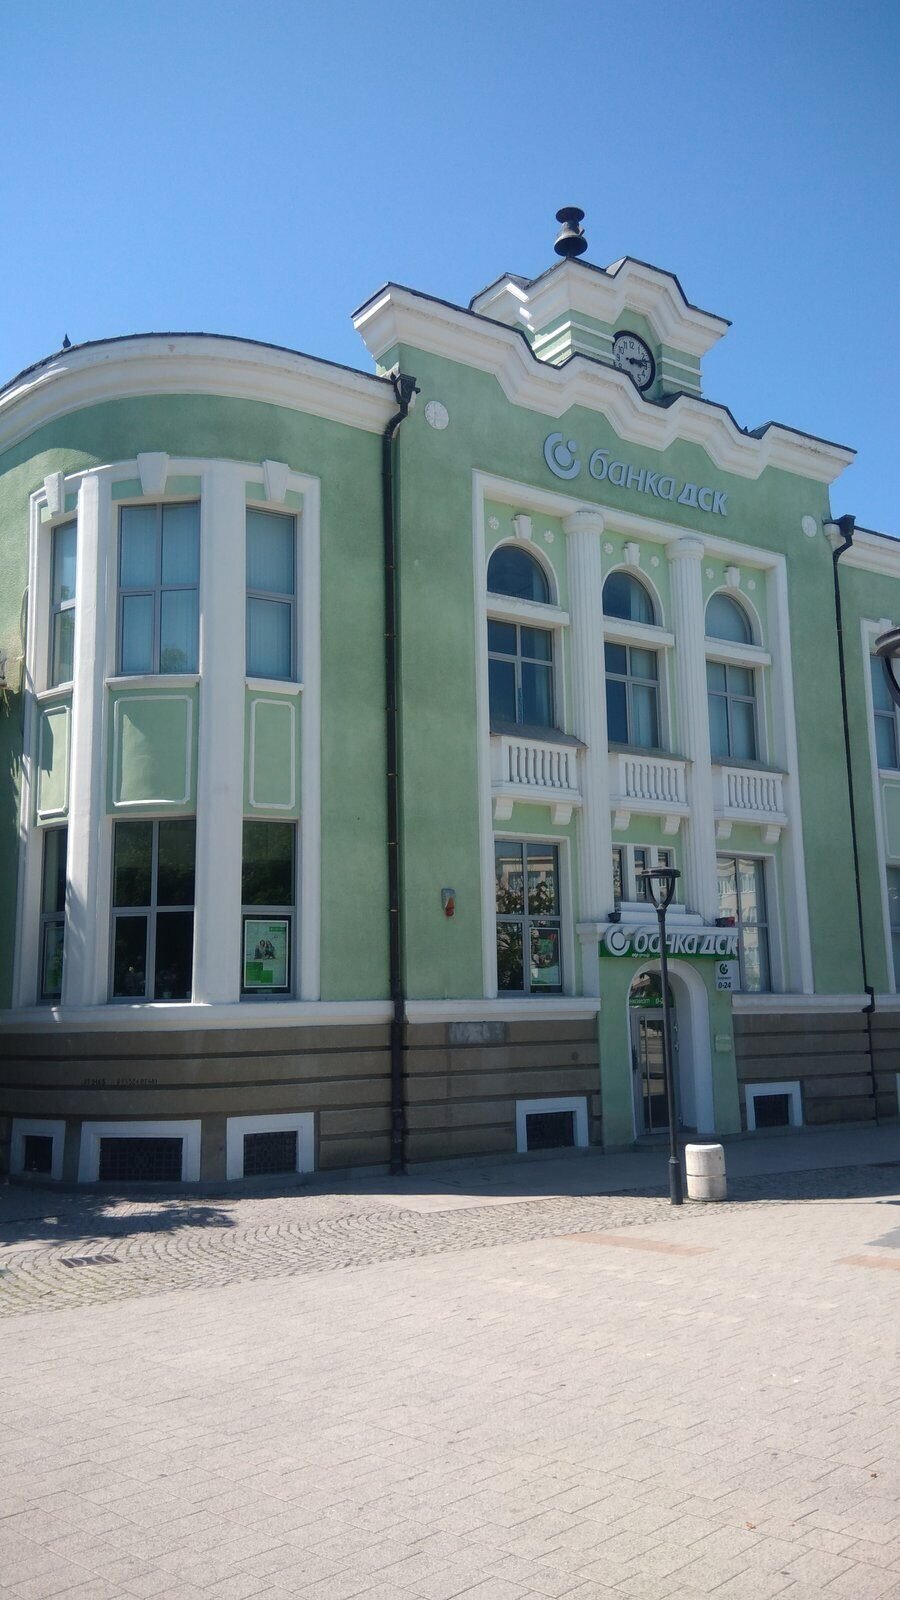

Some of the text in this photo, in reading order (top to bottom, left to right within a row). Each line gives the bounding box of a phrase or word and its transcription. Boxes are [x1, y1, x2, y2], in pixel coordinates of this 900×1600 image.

[618, 345, 625, 355] 10
[629, 341, 635, 350] 12
[588, 448, 676, 502] банка
[718, 981, 732, 990] 0-24
[655, 997, 664, 1005] 0-2
